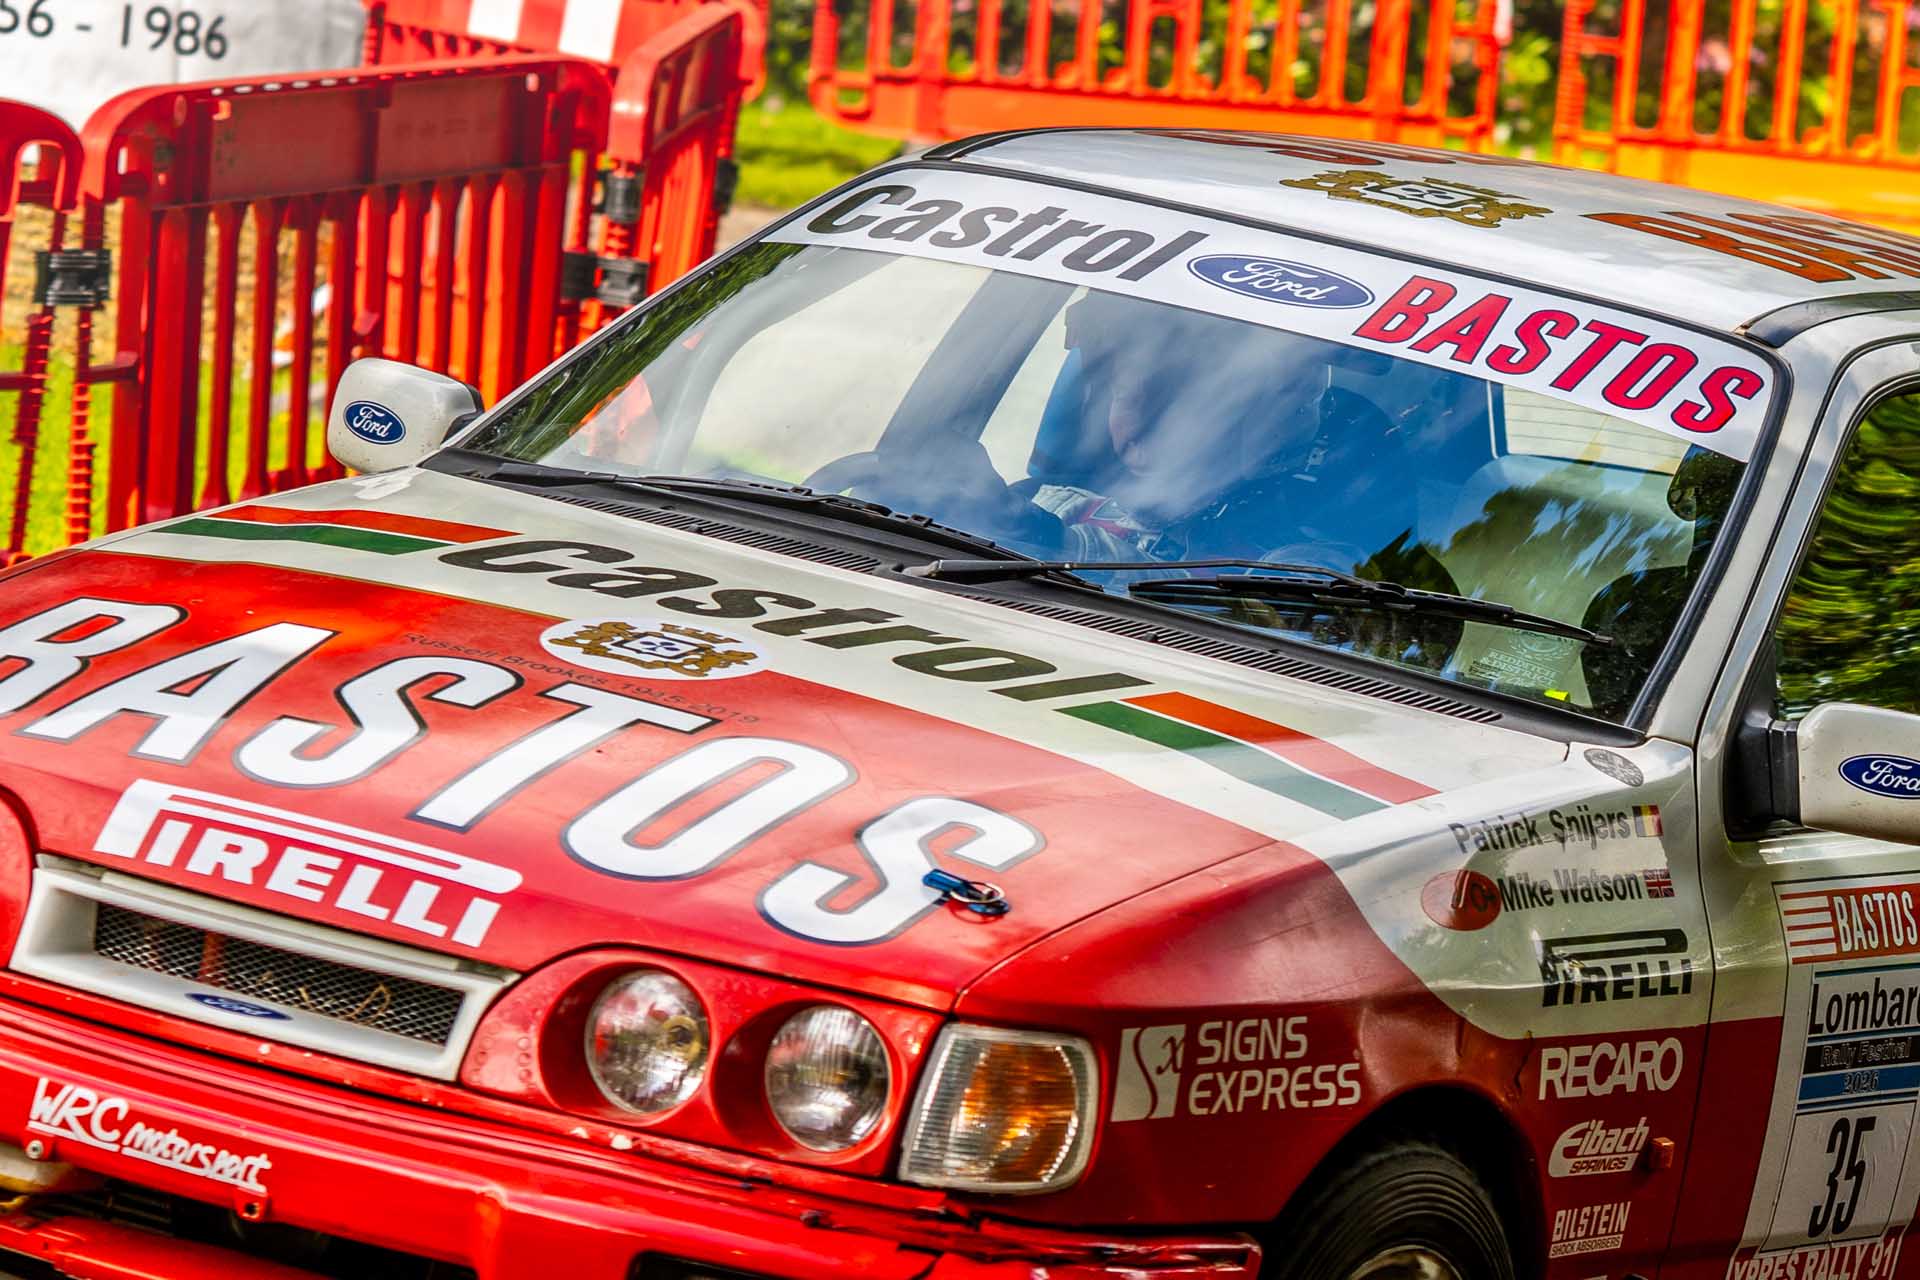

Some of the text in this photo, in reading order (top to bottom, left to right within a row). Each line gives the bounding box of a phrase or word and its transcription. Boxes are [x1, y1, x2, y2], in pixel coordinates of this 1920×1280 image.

[121, 4, 229, 60] 1986
[806, 184, 1764, 433] Castrol Ford BASTOS
[353, 406, 393, 437] Ford
[437, 540, 1153, 702] Castrol
[404, 632, 497, 658] Russell
[502, 655, 610, 686] Brookes
[0, 597, 1046, 946] BASTOS
[1448, 805, 1631, 853] Patrick Snijers
[92, 778, 523, 948] PIRELLI
[1497, 868, 1642, 912] Mike Watson
[1832, 891, 1919, 952] BASTOS
[1536, 929, 1693, 1008] PIRELLI
[1808, 977, 1920, 1036] Lombar
[1197, 1016, 1308, 1065] SIGNS
[1820, 1037, 1912, 1069] Rally Festival
[1188, 1063, 1361, 1116] EXPRESS
[1538, 1037, 1684, 1101] RECARO
[28, 1077, 129, 1145] WRC
[1548, 1116, 1649, 1177] Eibach
[1568, 1157, 1629, 1175] SPRINGS
[1808, 1116, 1877, 1238] 35
[1551, 1236, 1621, 1256] SHOCK ABSORBERS
[1552, 1201, 1632, 1242] BILSTEIN
[1802, 1242, 1868, 1280] RALLY
[1868, 1238, 1896, 1278] 91
